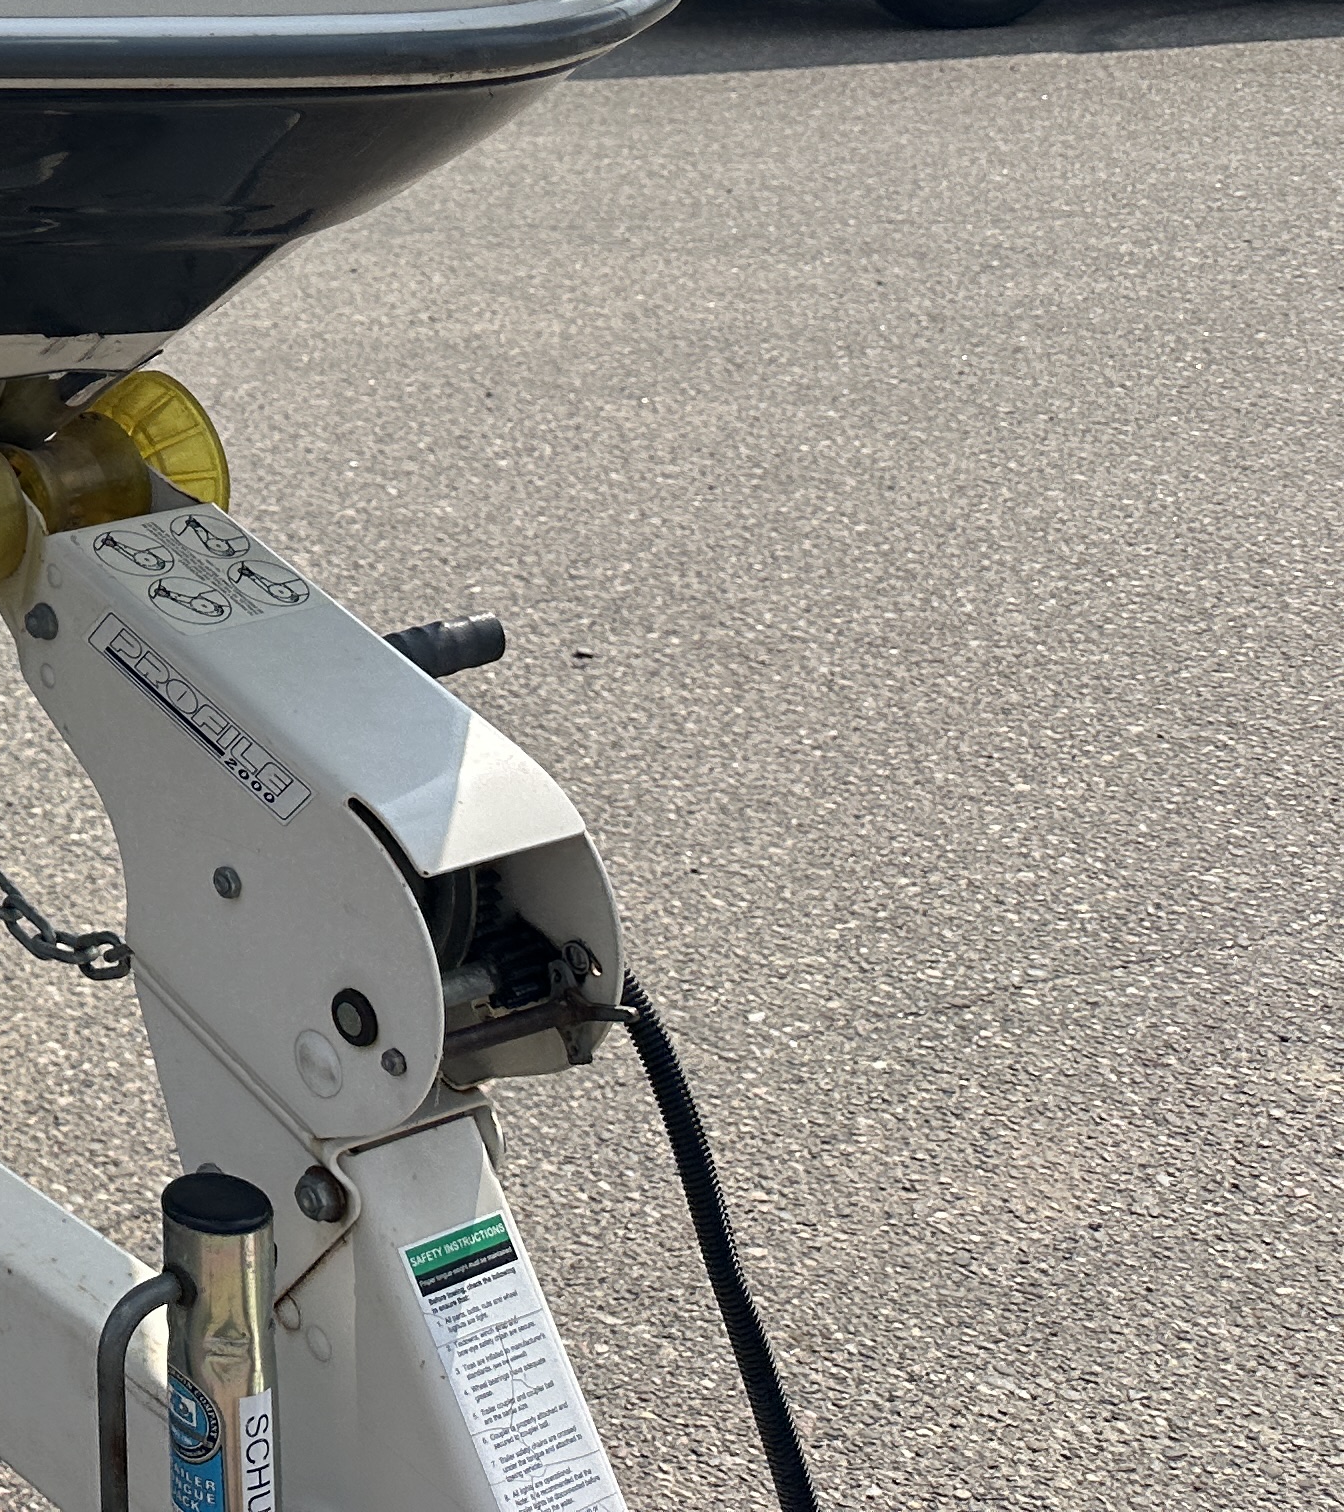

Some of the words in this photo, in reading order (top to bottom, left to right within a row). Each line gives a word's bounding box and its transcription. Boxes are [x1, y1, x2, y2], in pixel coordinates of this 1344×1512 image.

[110, 628, 293, 797] PROFILE
[224, 758, 275, 803] 2000
[410, 1246, 443, 1266] SAFETY
[443, 1222, 504, 1253] INSTRUCTIONS
[429, 1294, 445, 1304] Before
[466, 1280, 481, 1289] check
[492, 1267, 515, 1281] following
[439, 1301, 456, 1310] ensure
[492, 1295, 502, 1303] and
[503, 1290, 517, 1299] wheel
